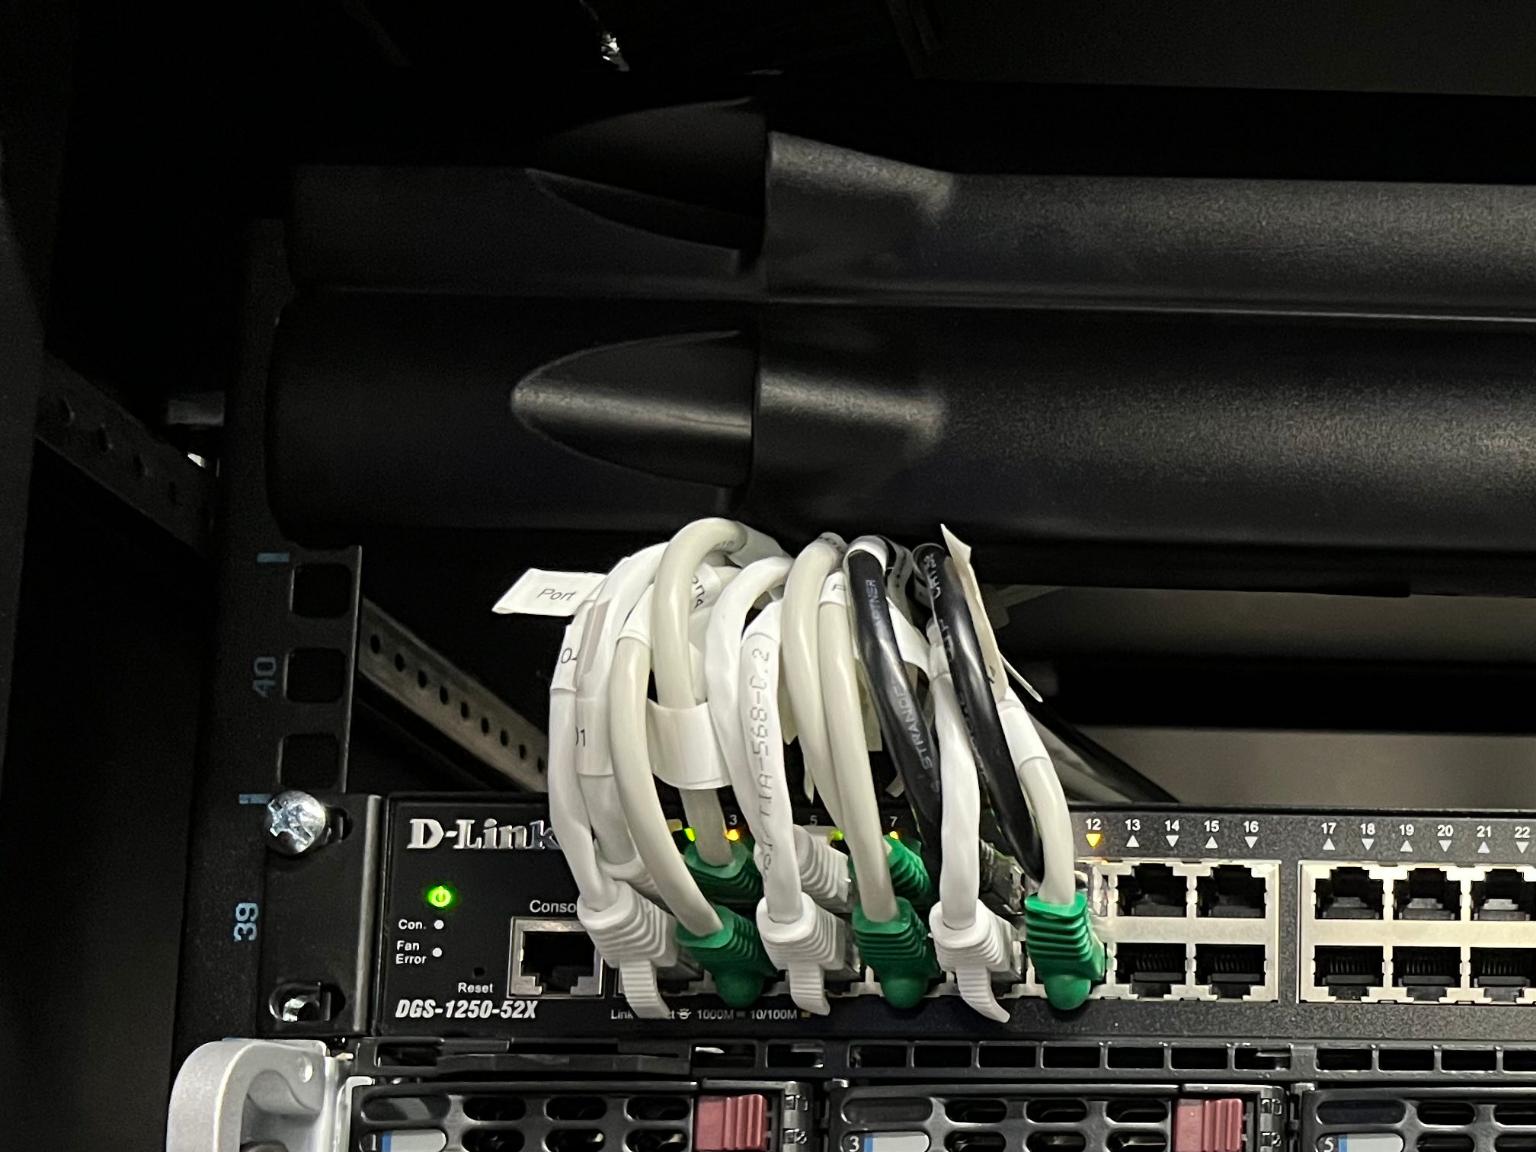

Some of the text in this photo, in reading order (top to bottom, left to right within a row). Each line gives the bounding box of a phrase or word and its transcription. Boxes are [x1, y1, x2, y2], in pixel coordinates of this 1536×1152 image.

[729, 815, 738, 825] 3
[889, 816, 898, 827] 7
[1085, 818, 1102, 831] 12
[1124, 818, 1141, 831] 13
[1164, 819, 1180, 832] 14
[1203, 819, 1220, 833] 15
[1243, 820, 1260, 833] 16
[406, 818, 563, 850] D-Link
[1320, 822, 1337, 835] 17
[1360, 822, 1376, 836] 18
[1399, 823, 1415, 836] 19
[1437, 824, 1454, 837] 20
[1476, 825, 1492, 838] 21
[1514, 825, 1531, 839] 22
[529, 901, 577, 913] Conso
[233, 901, 260, 942] 39
[396, 940, 420, 951] Fan
[395, 953, 427, 965] Error
[457, 982, 494, 994] Reset
[395, 999, 538, 1019] DGS-1250-52X
[370, 1133, 378, 1152] 1
